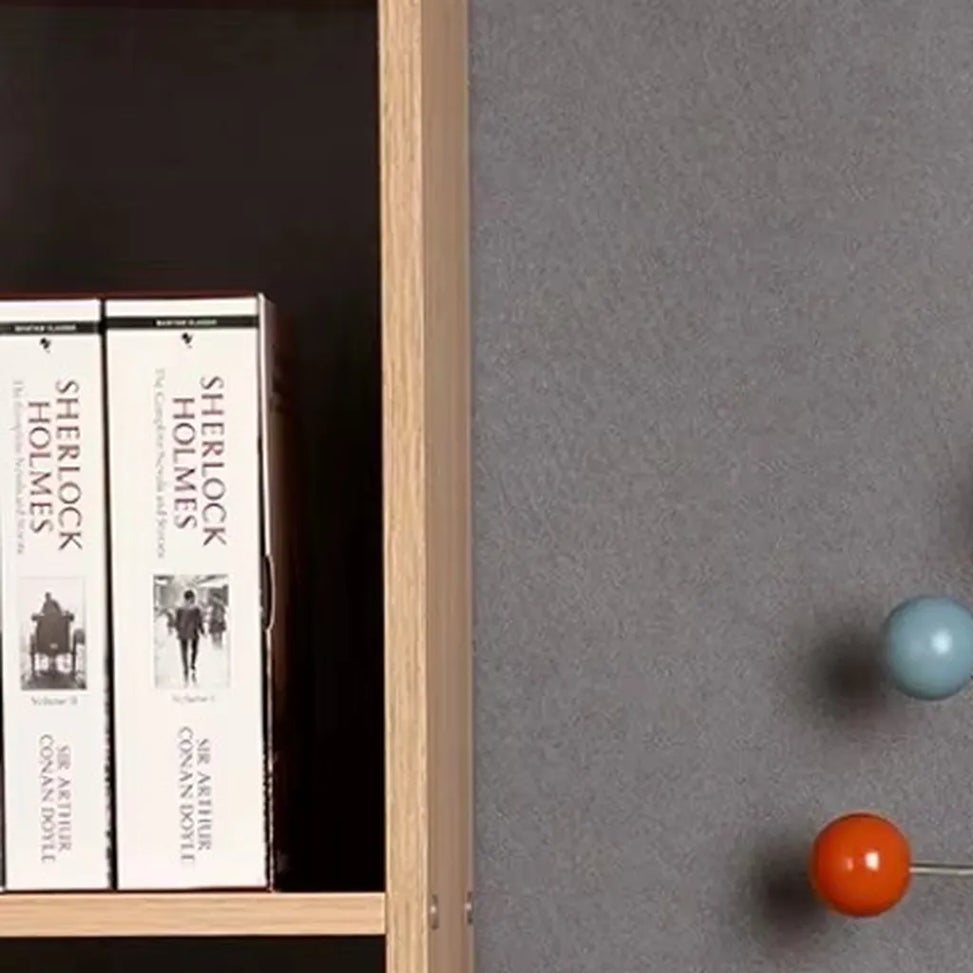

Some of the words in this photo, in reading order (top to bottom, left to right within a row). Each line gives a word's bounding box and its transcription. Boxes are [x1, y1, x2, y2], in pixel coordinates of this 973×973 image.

[28, 401, 53, 534] HOLMES
[55, 380, 82, 551] SHERLOCK
[172, 397, 197, 530] HOLMES
[200, 375, 227, 547] SHERLOCK
[39, 734, 54, 802] CONAN
[56, 745, 71, 770] SIR
[178, 726, 194, 800] CONAN
[196, 738, 211, 765] SIR
[41, 807, 56, 863] DOYLE
[57, 776, 72, 852] ARTHUR
[180, 804, 196, 863] DOYLE
[197, 771, 212, 851] ARTHUR
